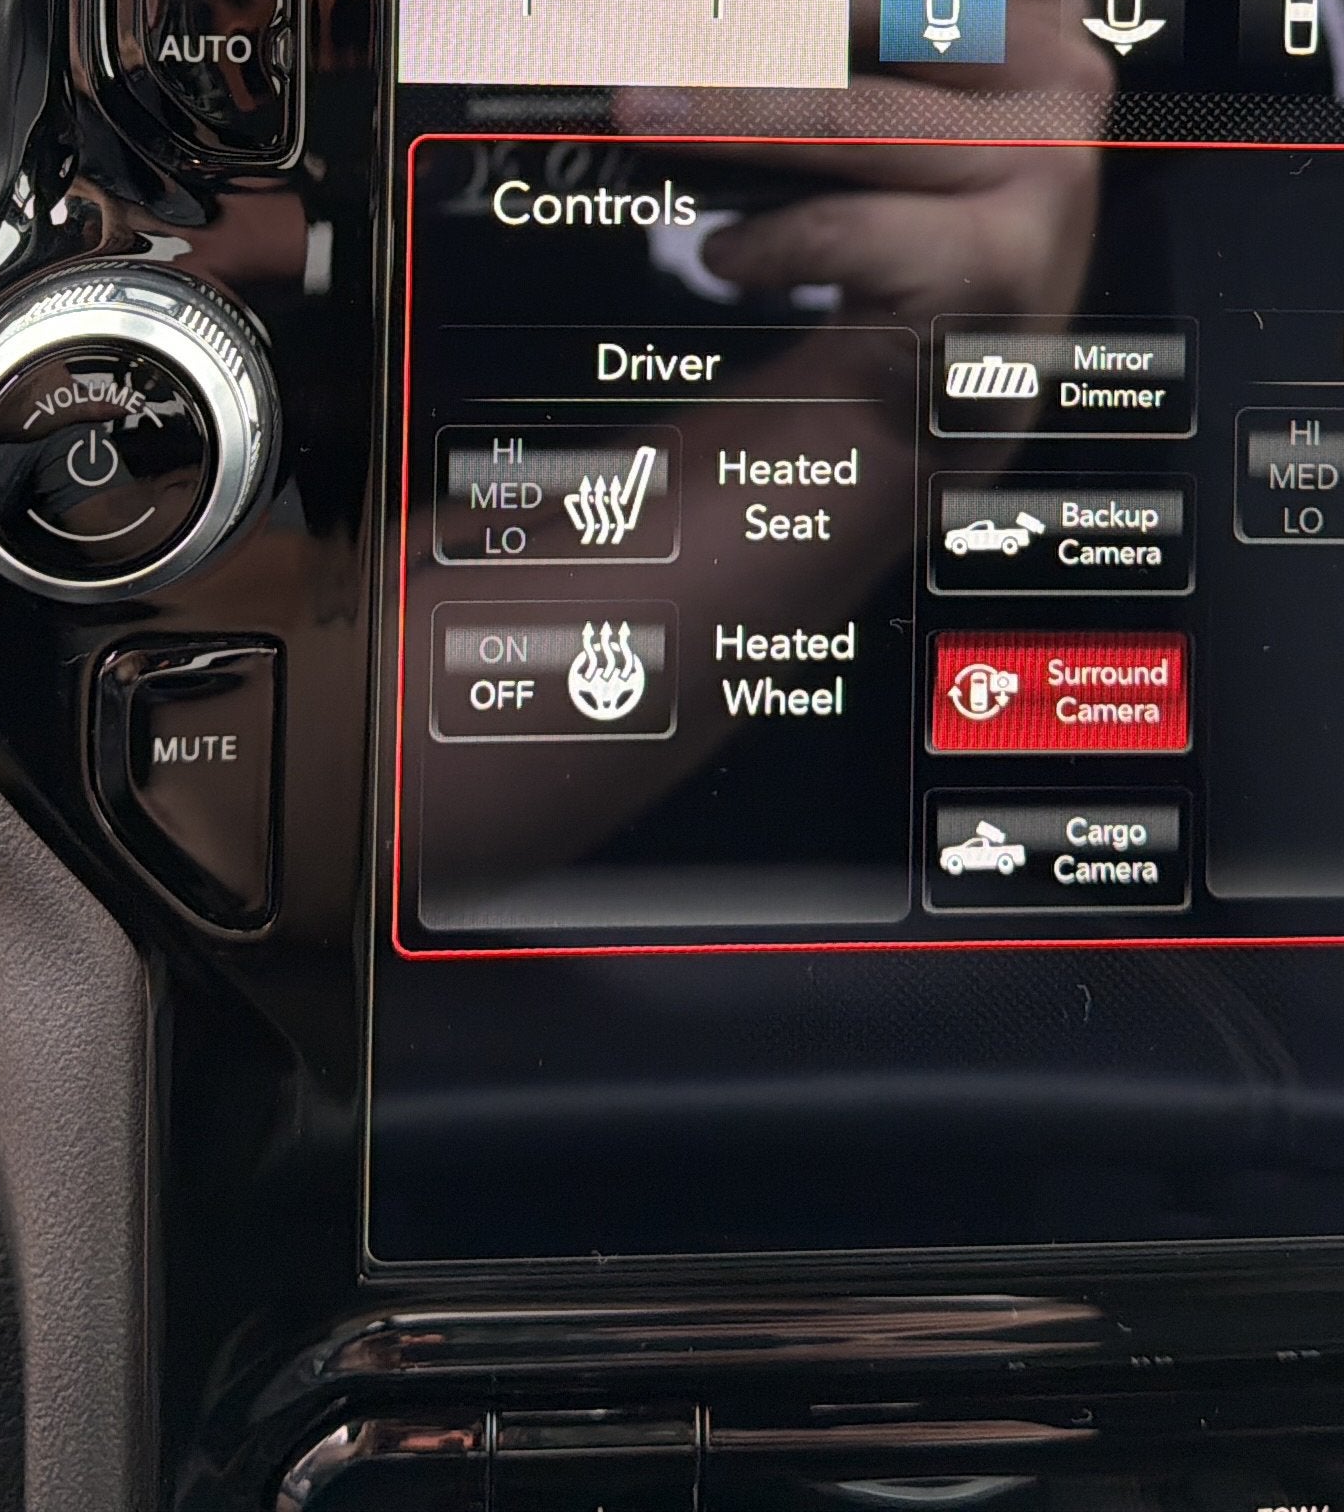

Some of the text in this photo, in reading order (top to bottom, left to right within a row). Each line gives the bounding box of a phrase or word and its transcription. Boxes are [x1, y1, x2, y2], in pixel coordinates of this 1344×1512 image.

[158, 34, 253, 64] AUTO
[493, 180, 698, 226] Controls
[596, 343, 721, 382] Driver
[1073, 344, 1154, 371] Mirror
[35, 380, 147, 416] VOLUME
[1060, 382, 1167, 409] Dimmer
[1289, 419, 1322, 447] HI
[491, 438, 525, 465] HI
[718, 447, 859, 486] Heated
[1268, 463, 1340, 491] MED
[469, 482, 544, 510] MED
[744, 503, 832, 542] Seat
[1061, 502, 1160, 534] Backup
[1283, 506, 1324, 534] LO
[484, 527, 528, 556] LO
[1057, 540, 1163, 566] Camera
[478, 634, 528, 664] ON
[715, 621, 856, 661] Heated
[1047, 658, 1169, 688] Surround
[469, 679, 536, 711] OFF
[722, 676, 844, 716] Wheel
[1055, 697, 1161, 725] Camera
[152, 735, 238, 763] MUTE
[1065, 817, 1148, 852] Cargo
[1053, 855, 1159, 885] Camera
